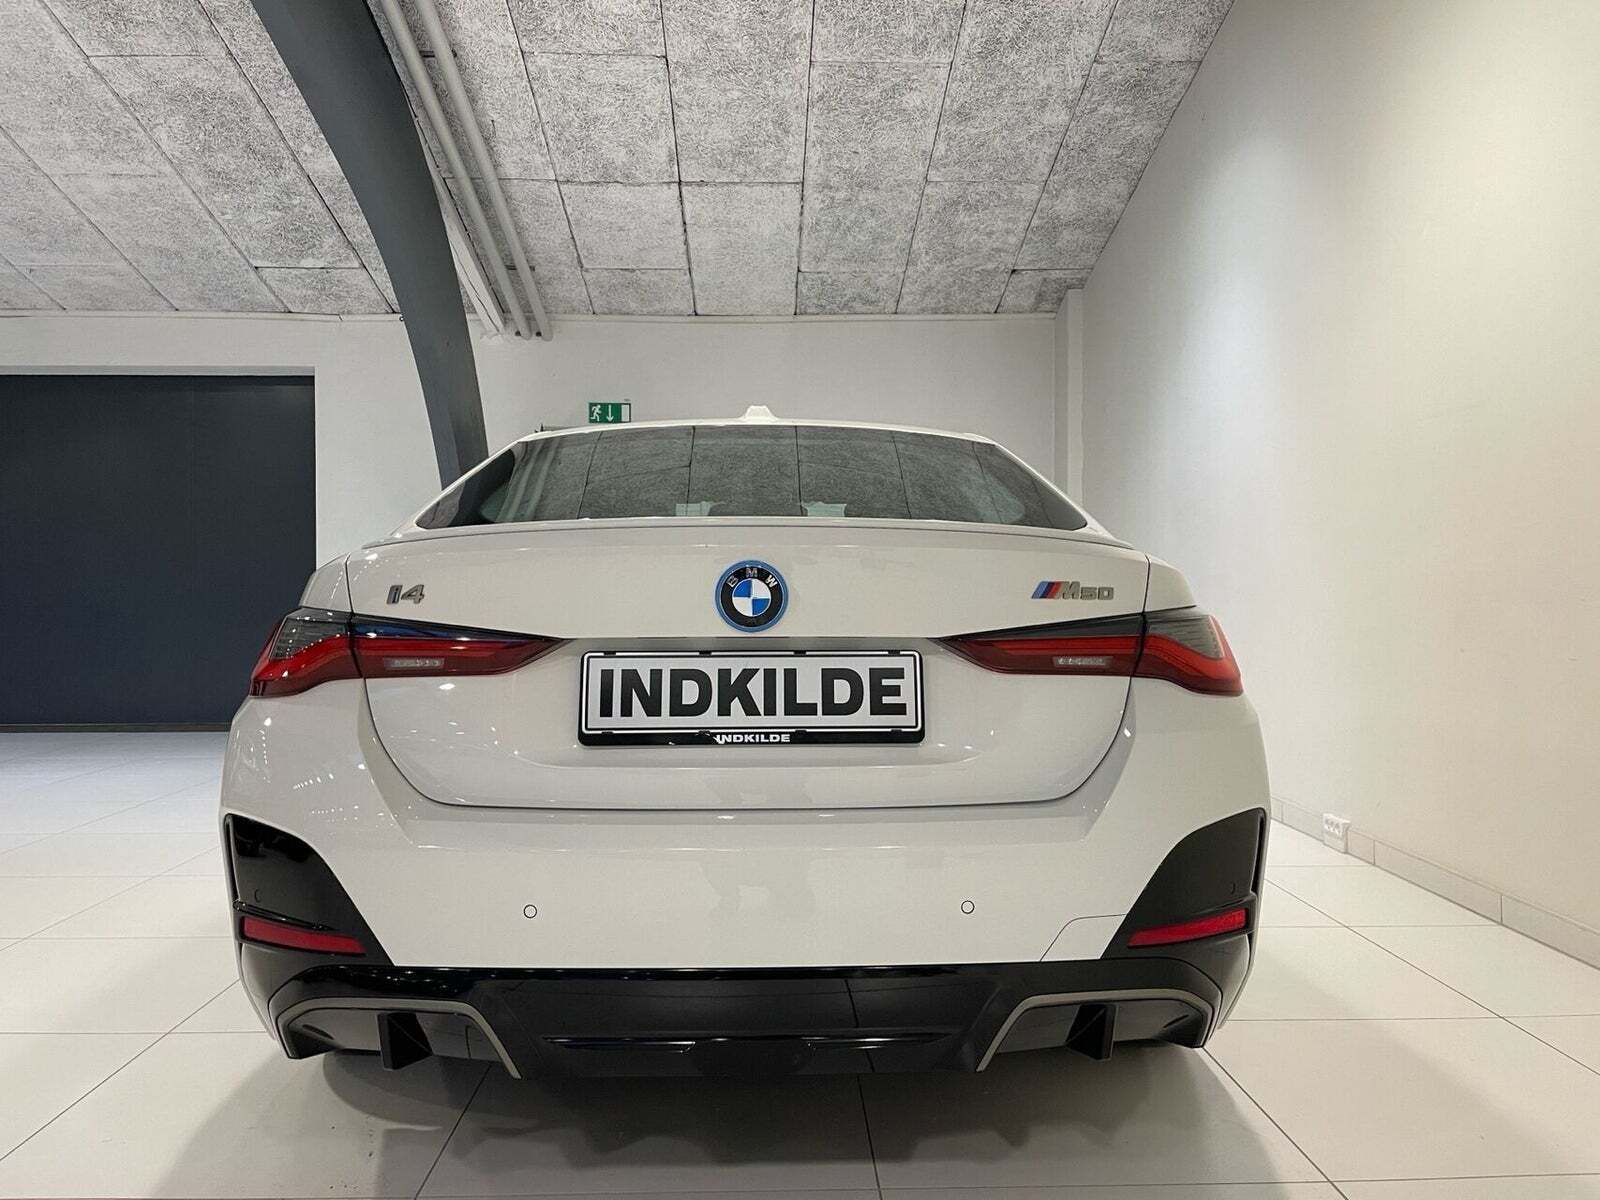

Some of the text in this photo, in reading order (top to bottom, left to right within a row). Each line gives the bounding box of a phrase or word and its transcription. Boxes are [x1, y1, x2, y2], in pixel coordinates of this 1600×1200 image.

[726, 567, 778, 588] BMW
[386, 584, 425, 605] i4
[1054, 581, 1114, 600] M50
[600, 668, 908, 718] INDKILDE
[714, 734, 791, 744] INDKILDE
